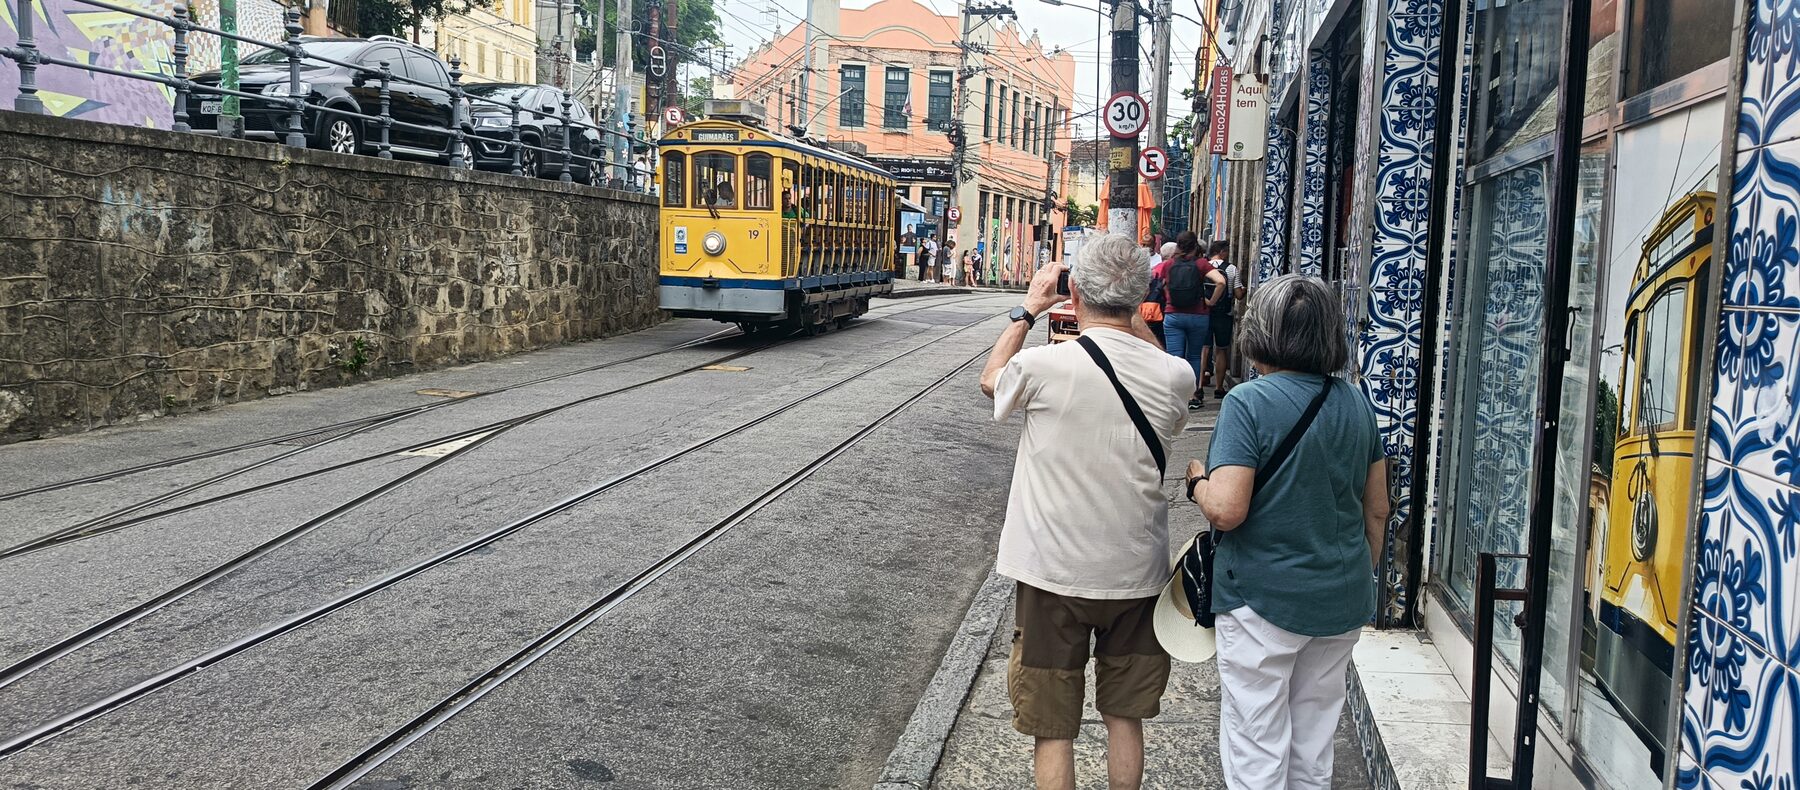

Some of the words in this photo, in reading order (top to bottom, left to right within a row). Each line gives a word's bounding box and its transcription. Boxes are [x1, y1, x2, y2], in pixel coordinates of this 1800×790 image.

[1237, 84, 1262, 96] Aqui
[1236, 99, 1257, 108] tem
[670, 110, 677, 121] E
[1112, 101, 1141, 122] 30
[1213, 69, 1229, 152] Banco24Horas
[698, 132, 734, 141] GUIMARÃES
[1146, 153, 1158, 173] E
[748, 229, 759, 239] 19
